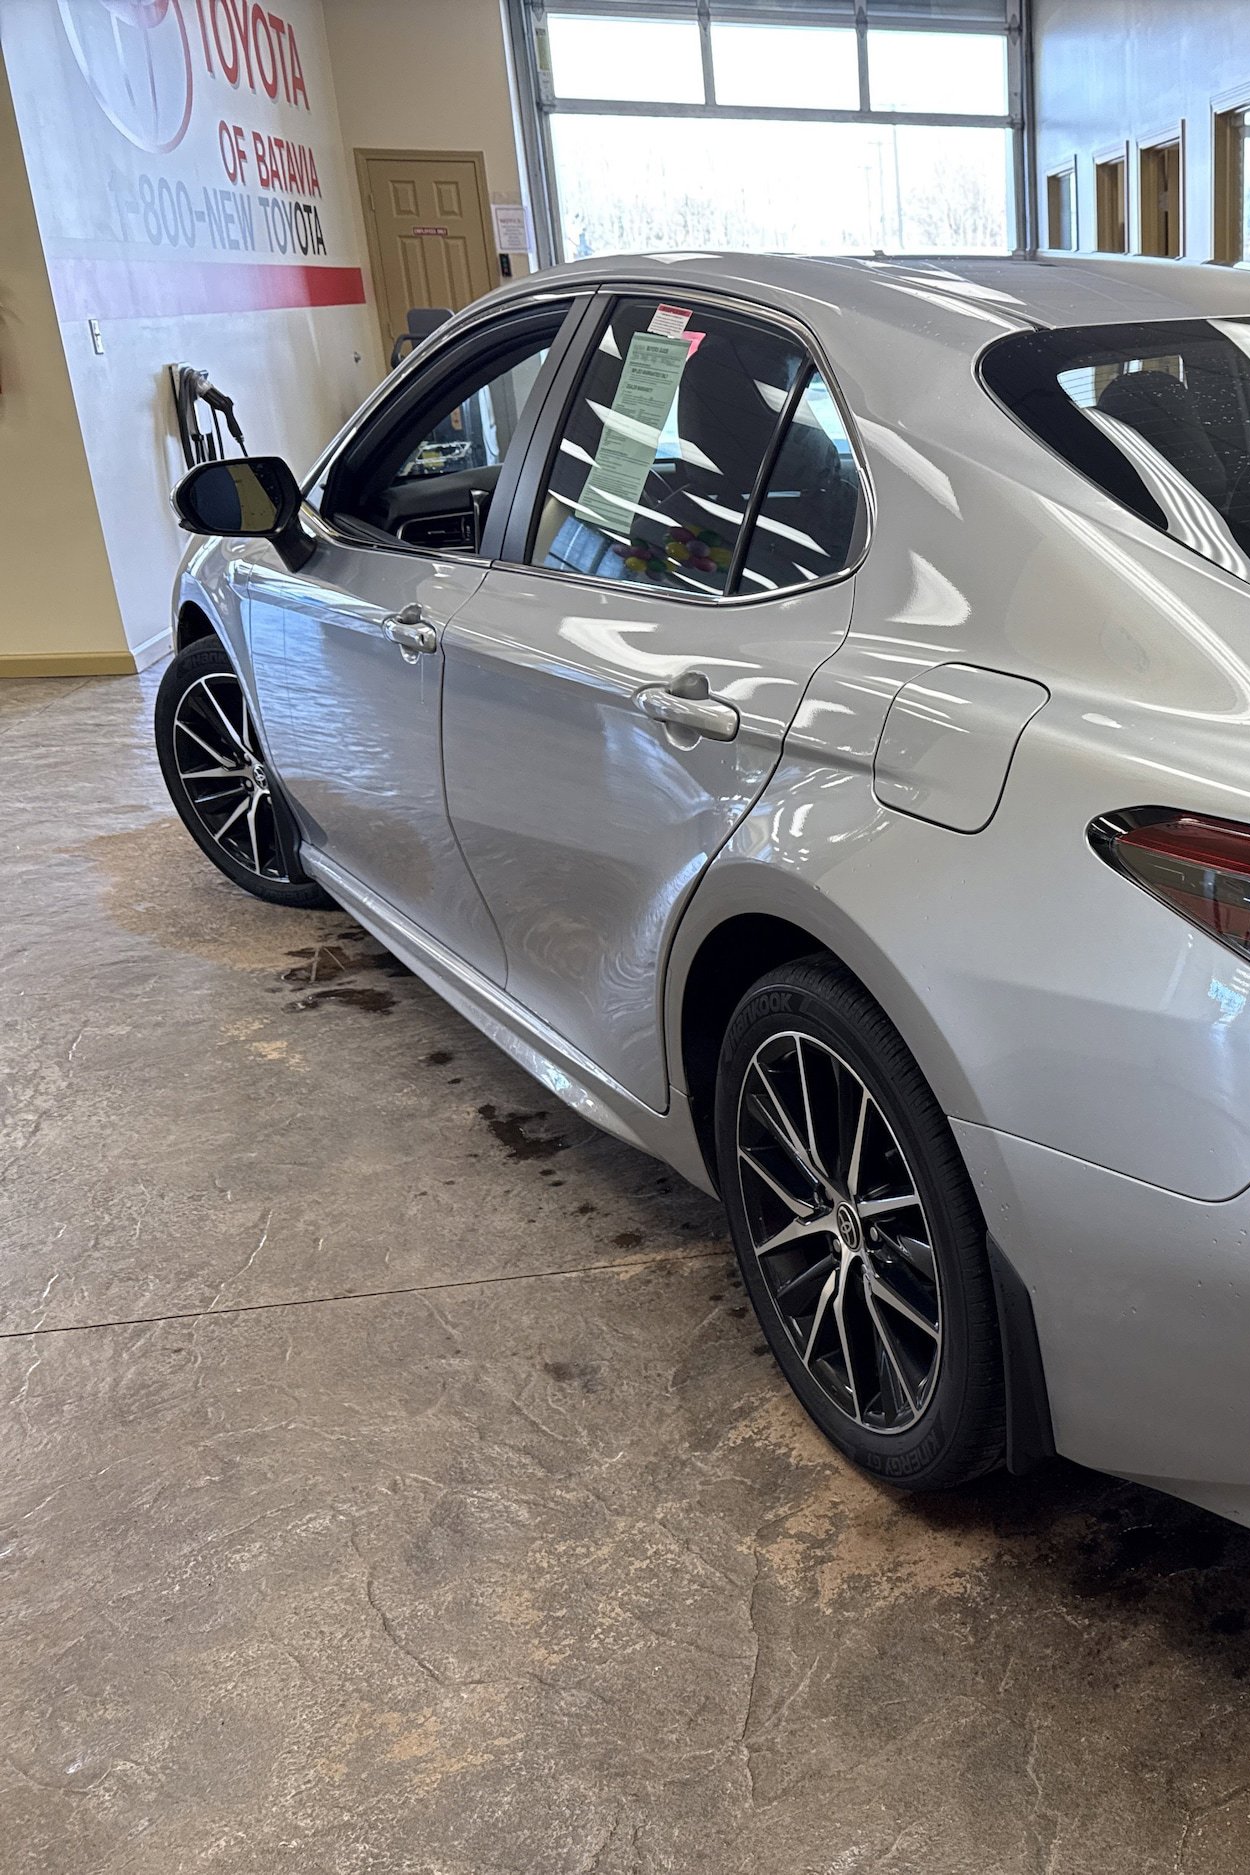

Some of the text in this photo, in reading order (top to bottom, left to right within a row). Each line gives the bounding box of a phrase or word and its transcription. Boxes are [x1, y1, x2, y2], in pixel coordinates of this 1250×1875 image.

[219, 120, 322, 199] OF BATAVIA
[258, 196, 327, 256] TOYOTA
